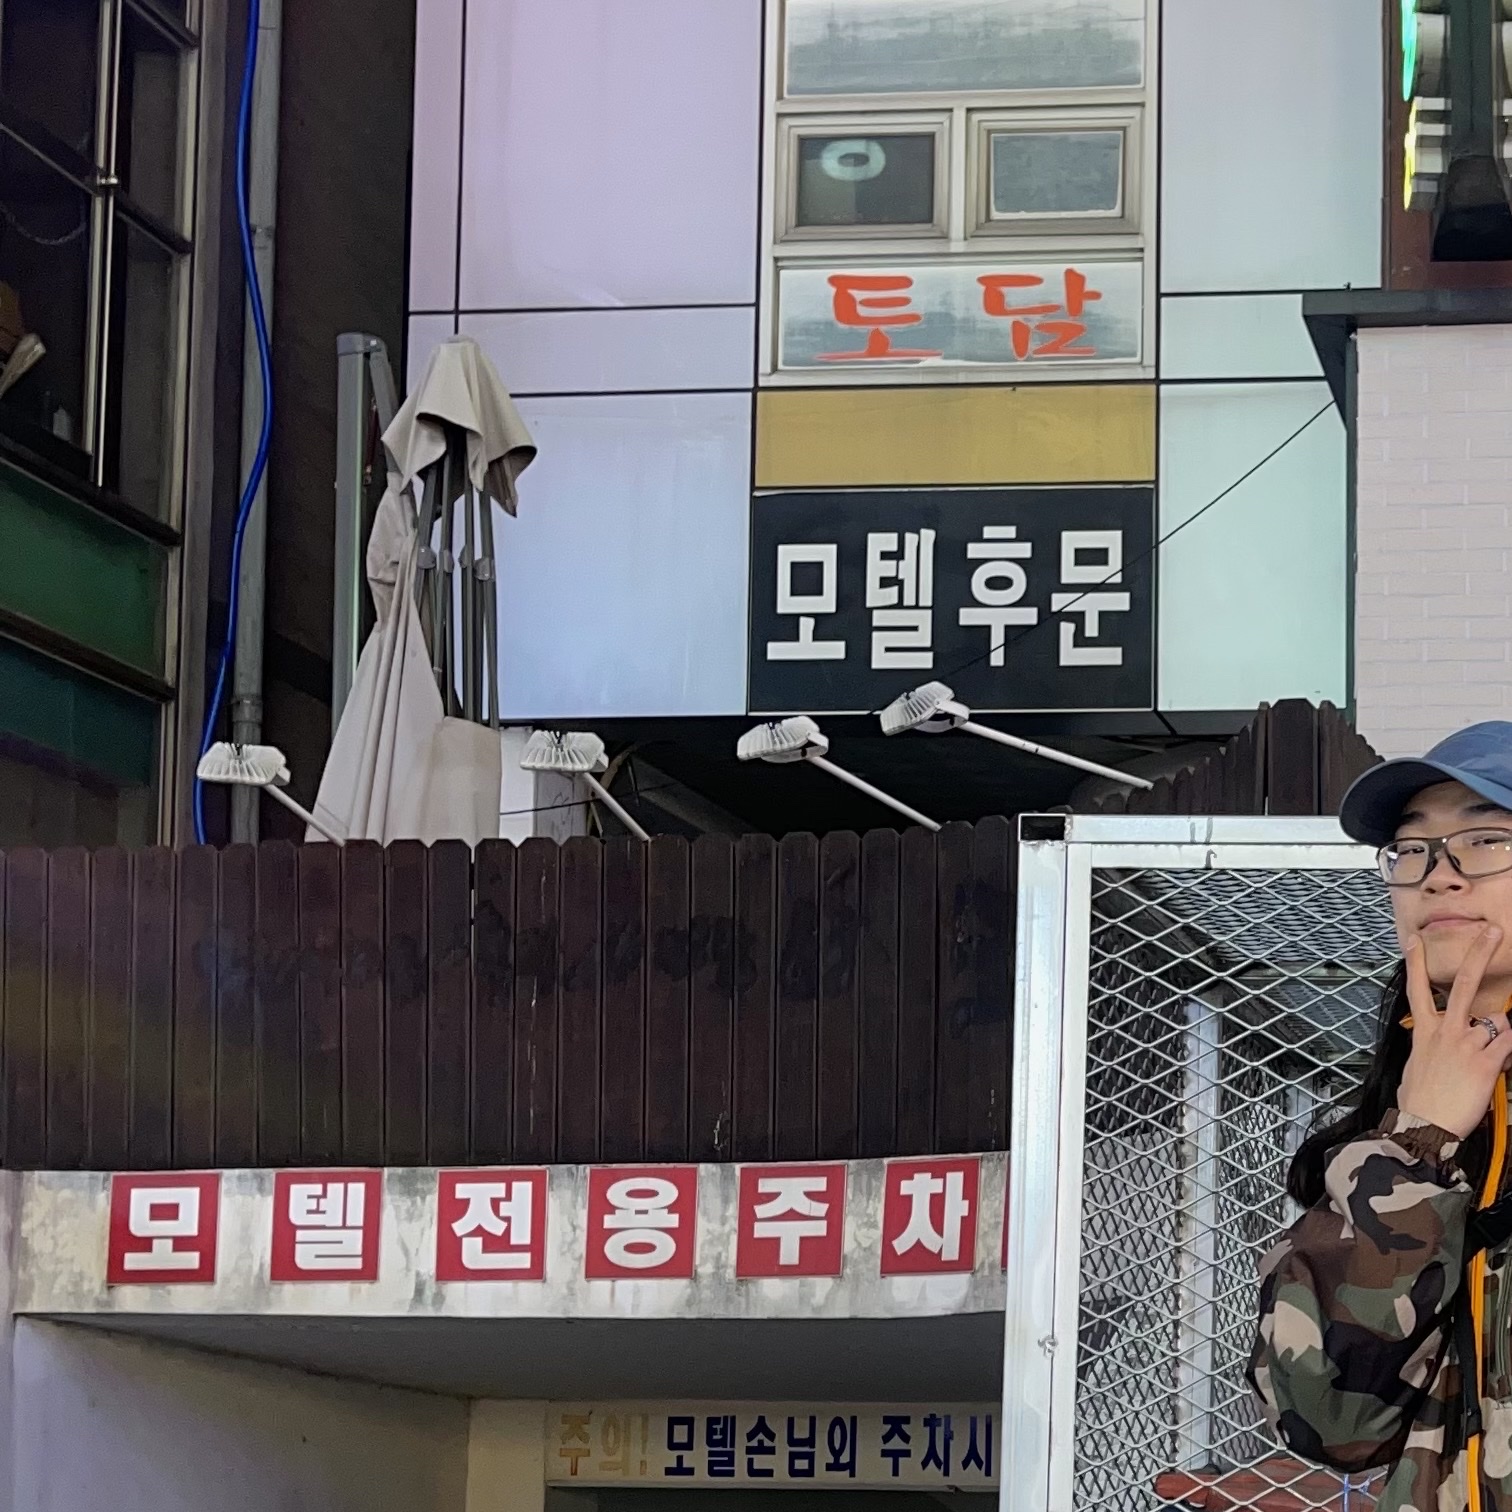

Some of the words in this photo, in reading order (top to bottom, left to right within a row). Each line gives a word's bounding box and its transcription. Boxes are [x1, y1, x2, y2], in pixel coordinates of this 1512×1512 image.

[765, 524, 1131, 670] 모텔후문
[664, 1414, 858, 1478] 모텔손님외
[880, 1413, 993, 1478] 주차시
